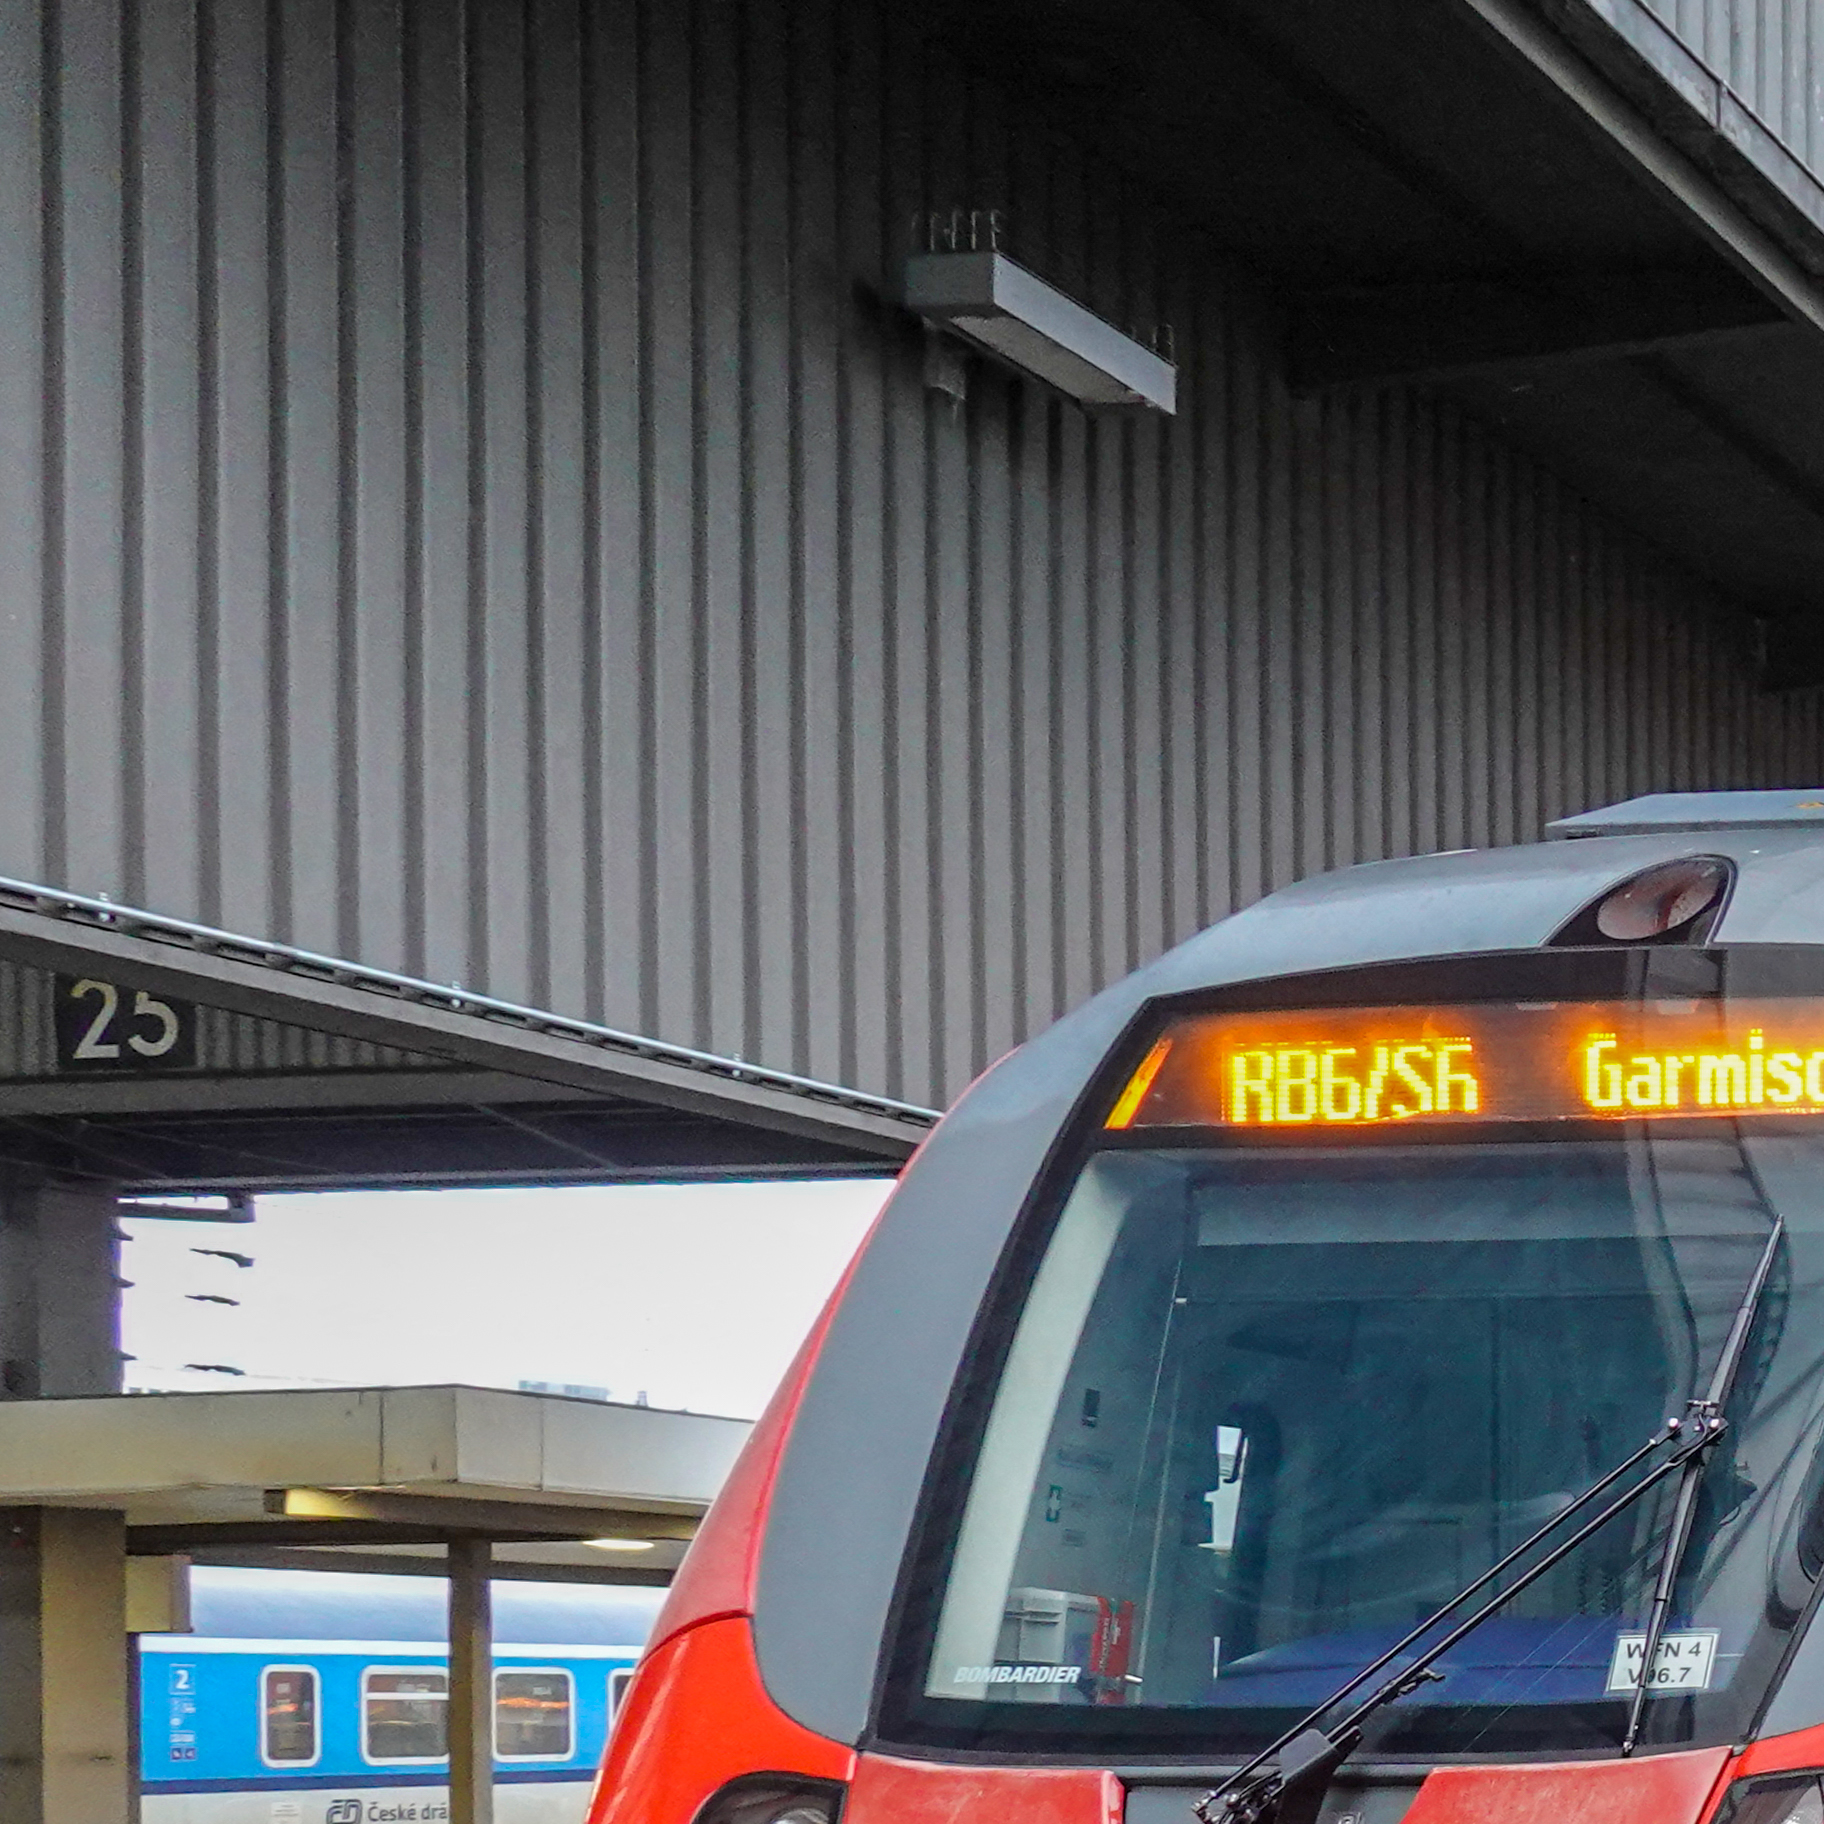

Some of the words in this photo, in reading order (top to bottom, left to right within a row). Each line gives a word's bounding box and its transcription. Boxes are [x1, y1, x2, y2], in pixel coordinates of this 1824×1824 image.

[70, 979, 179, 1060] 25
[1688, 1641, 1702, 1656] 4
[174, 1669, 191, 1690] 2
[953, 1666, 1082, 1684] BOMBARDIER
[367, 1801, 416, 1822] České
[421, 1801, 448, 1821] drá
